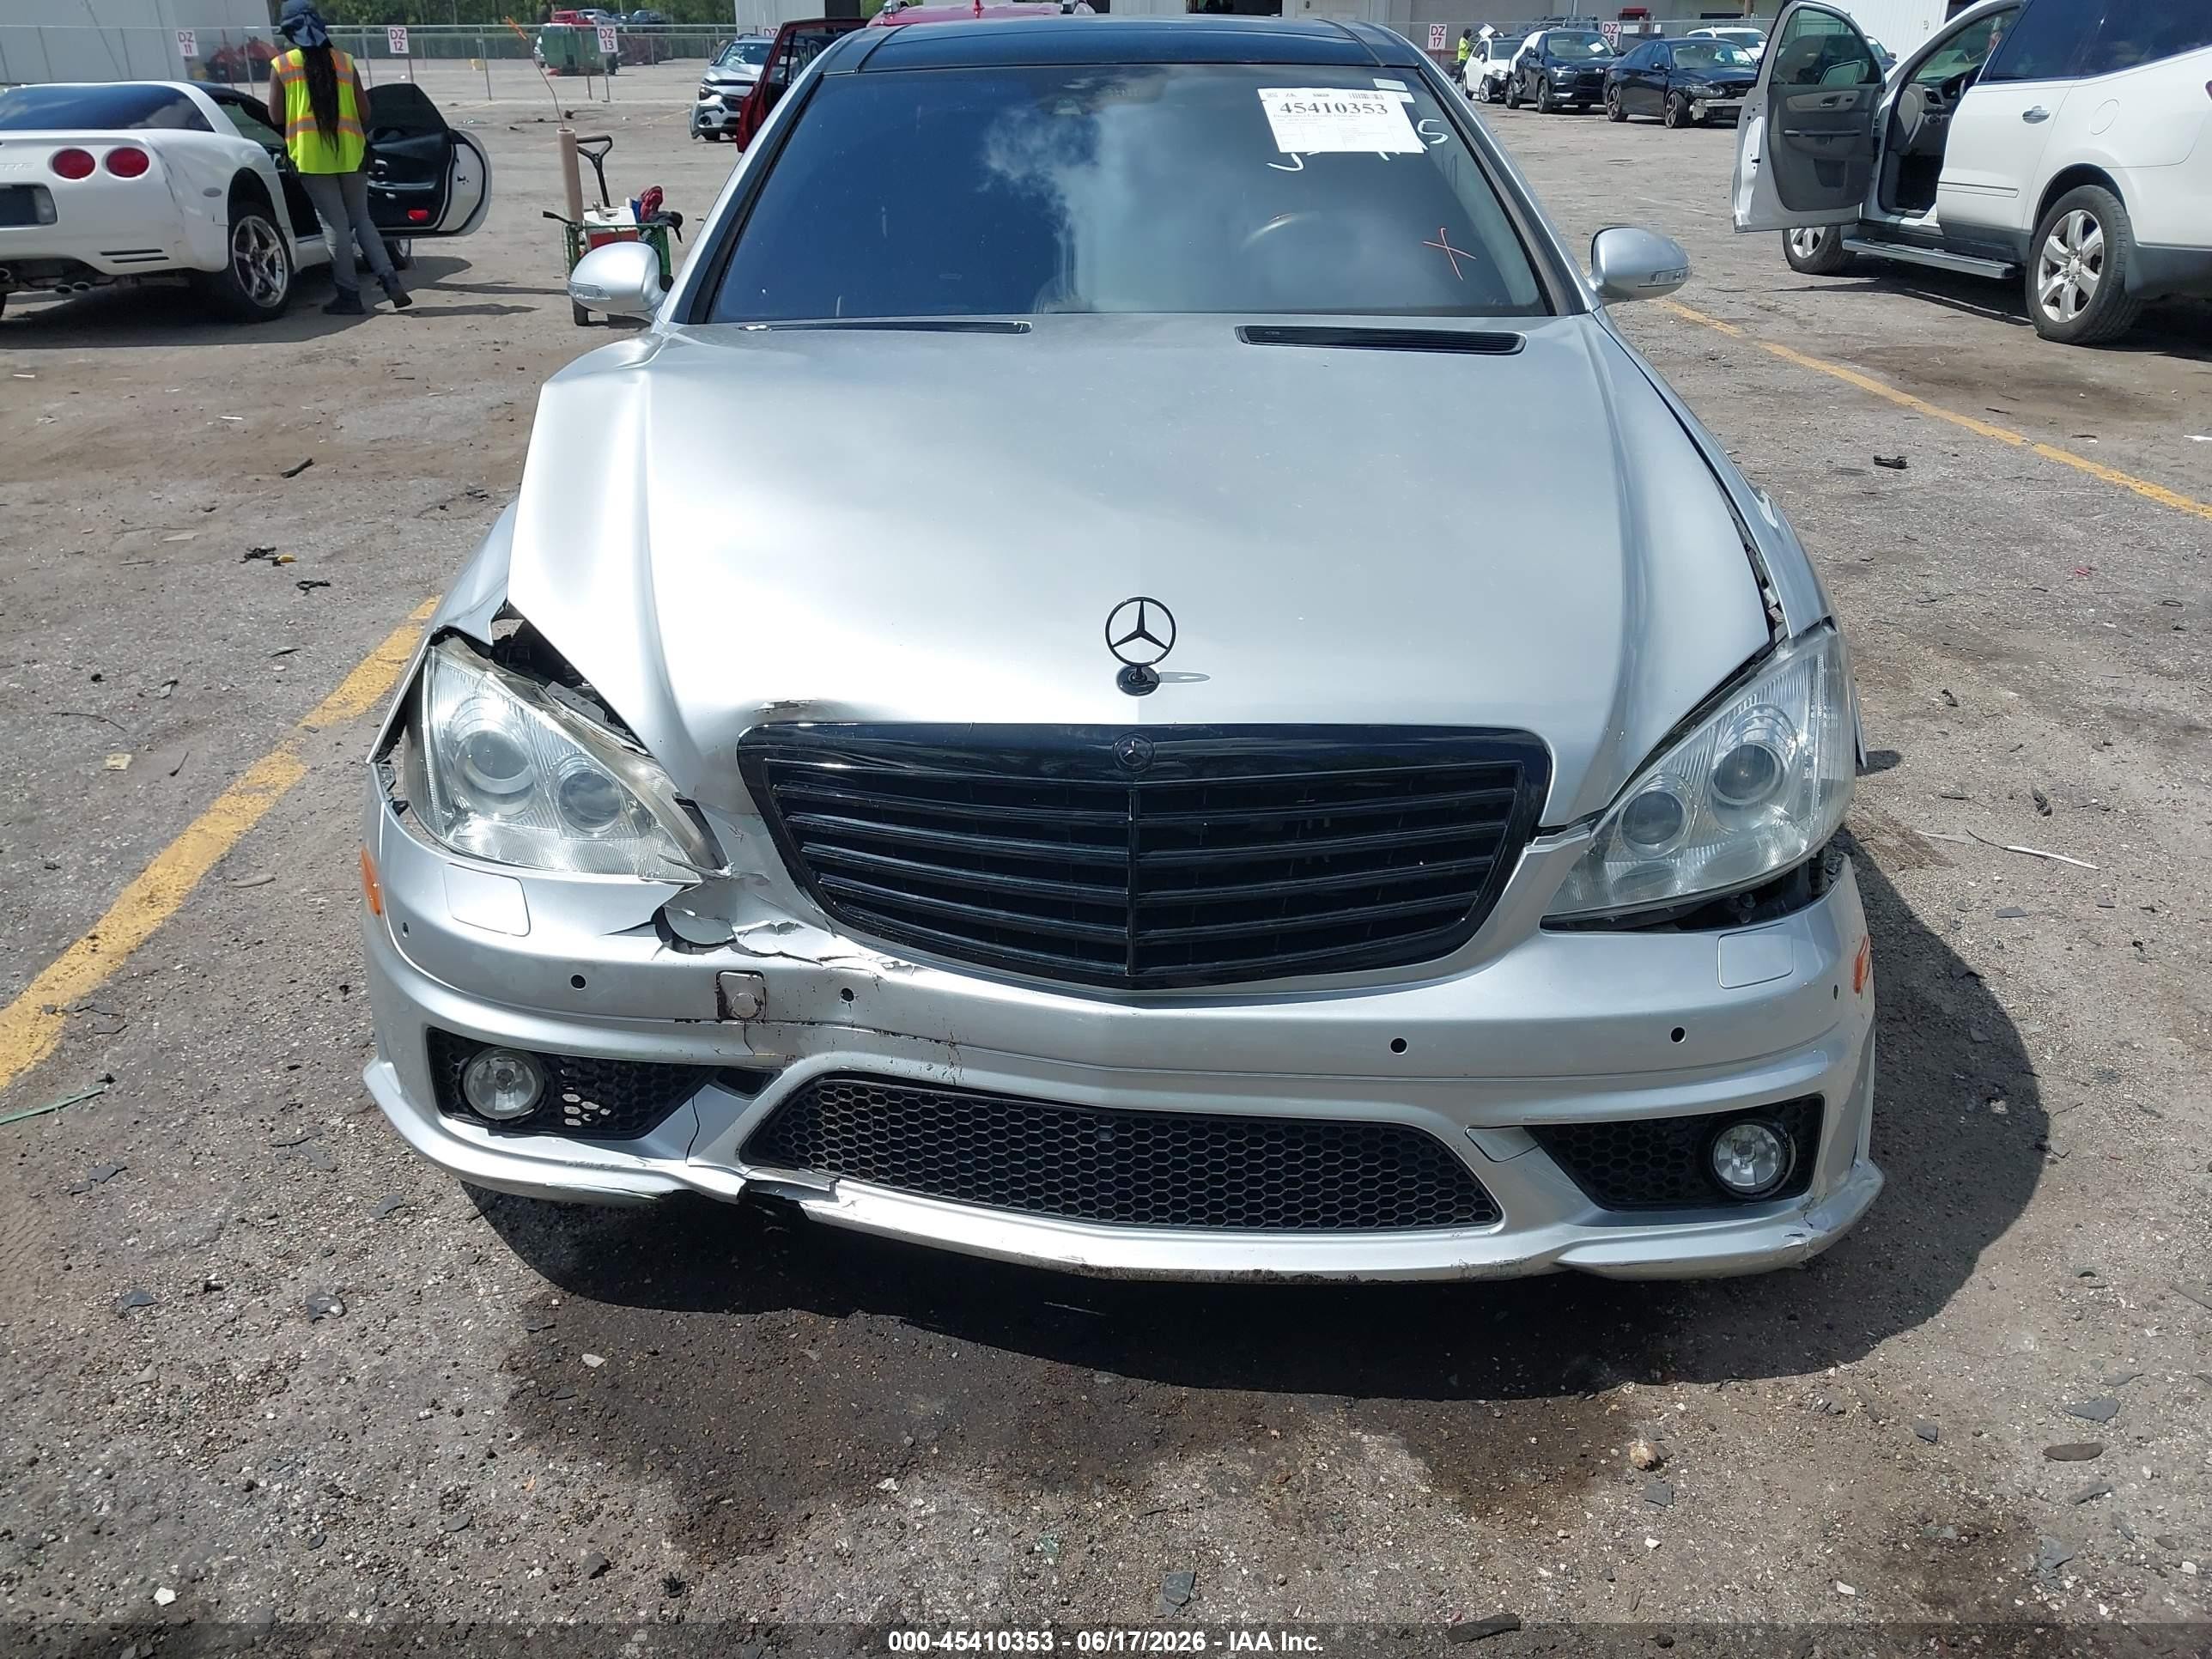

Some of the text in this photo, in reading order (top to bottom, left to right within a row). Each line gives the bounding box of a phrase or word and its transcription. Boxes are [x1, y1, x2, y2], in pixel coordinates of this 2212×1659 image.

[599, 27, 615, 39] DZ
[1431, 26, 1445, 36] DZ
[1603, 23, 1618, 33] DZ
[178, 31, 194, 42] DZ
[390, 28, 406, 40] DZ
[393, 40, 404, 52] 12
[604, 40, 614, 50] 13
[1433, 37, 1442, 47] 17
[184, 44, 193, 54] 11
[1279, 102, 1388, 115] 45410353
